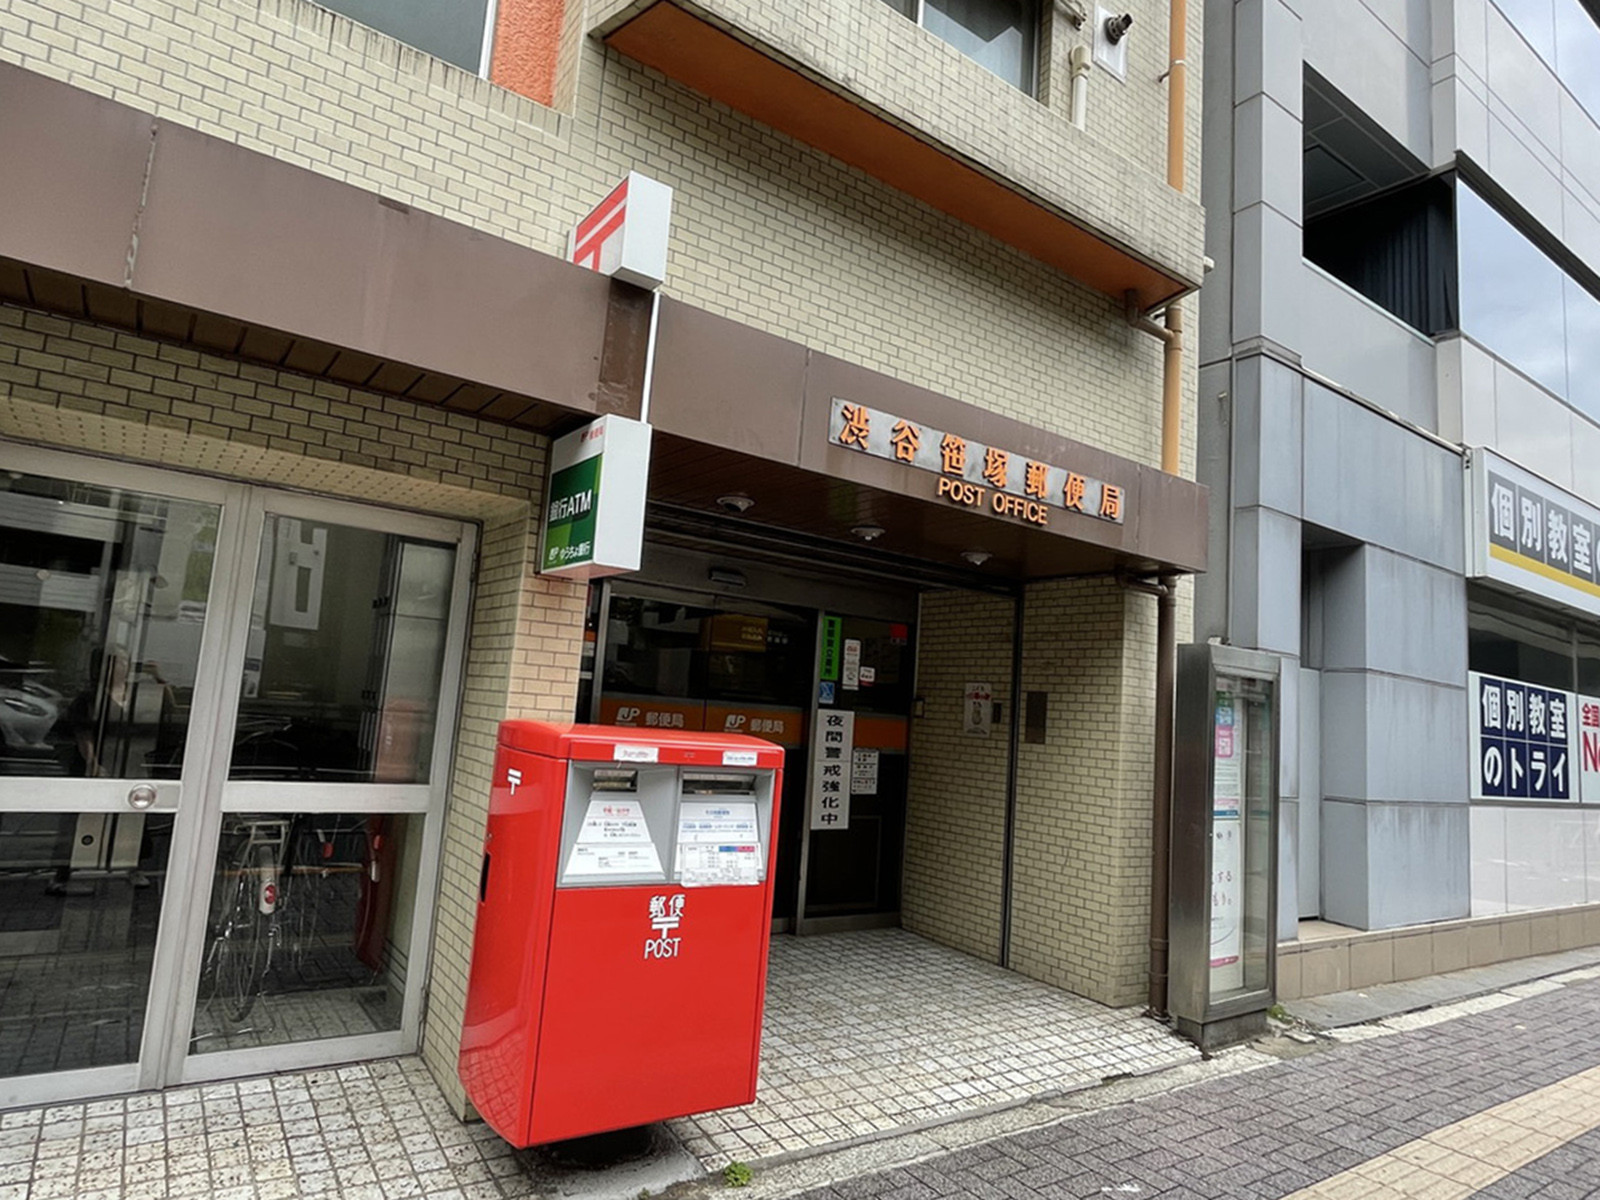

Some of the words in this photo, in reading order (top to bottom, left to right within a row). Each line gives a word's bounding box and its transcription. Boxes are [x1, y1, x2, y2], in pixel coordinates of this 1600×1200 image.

[839, 404, 1121, 520] 渋谷笹塚郵便局
[938, 477, 986, 507] POST
[992, 493, 1048, 525] OFFICE
[1491, 482, 1600, 574] 個別教室
[645, 711, 684, 728] 郵便局
[750, 718, 785, 734] 郵便局
[1482, 684, 1566, 739] 個別教室
[821, 715, 844, 825] 夜間警戒強化中
[1483, 746, 1566, 792] のトライ
[649, 894, 686, 918] 郵便
[644, 937, 682, 960] POST
